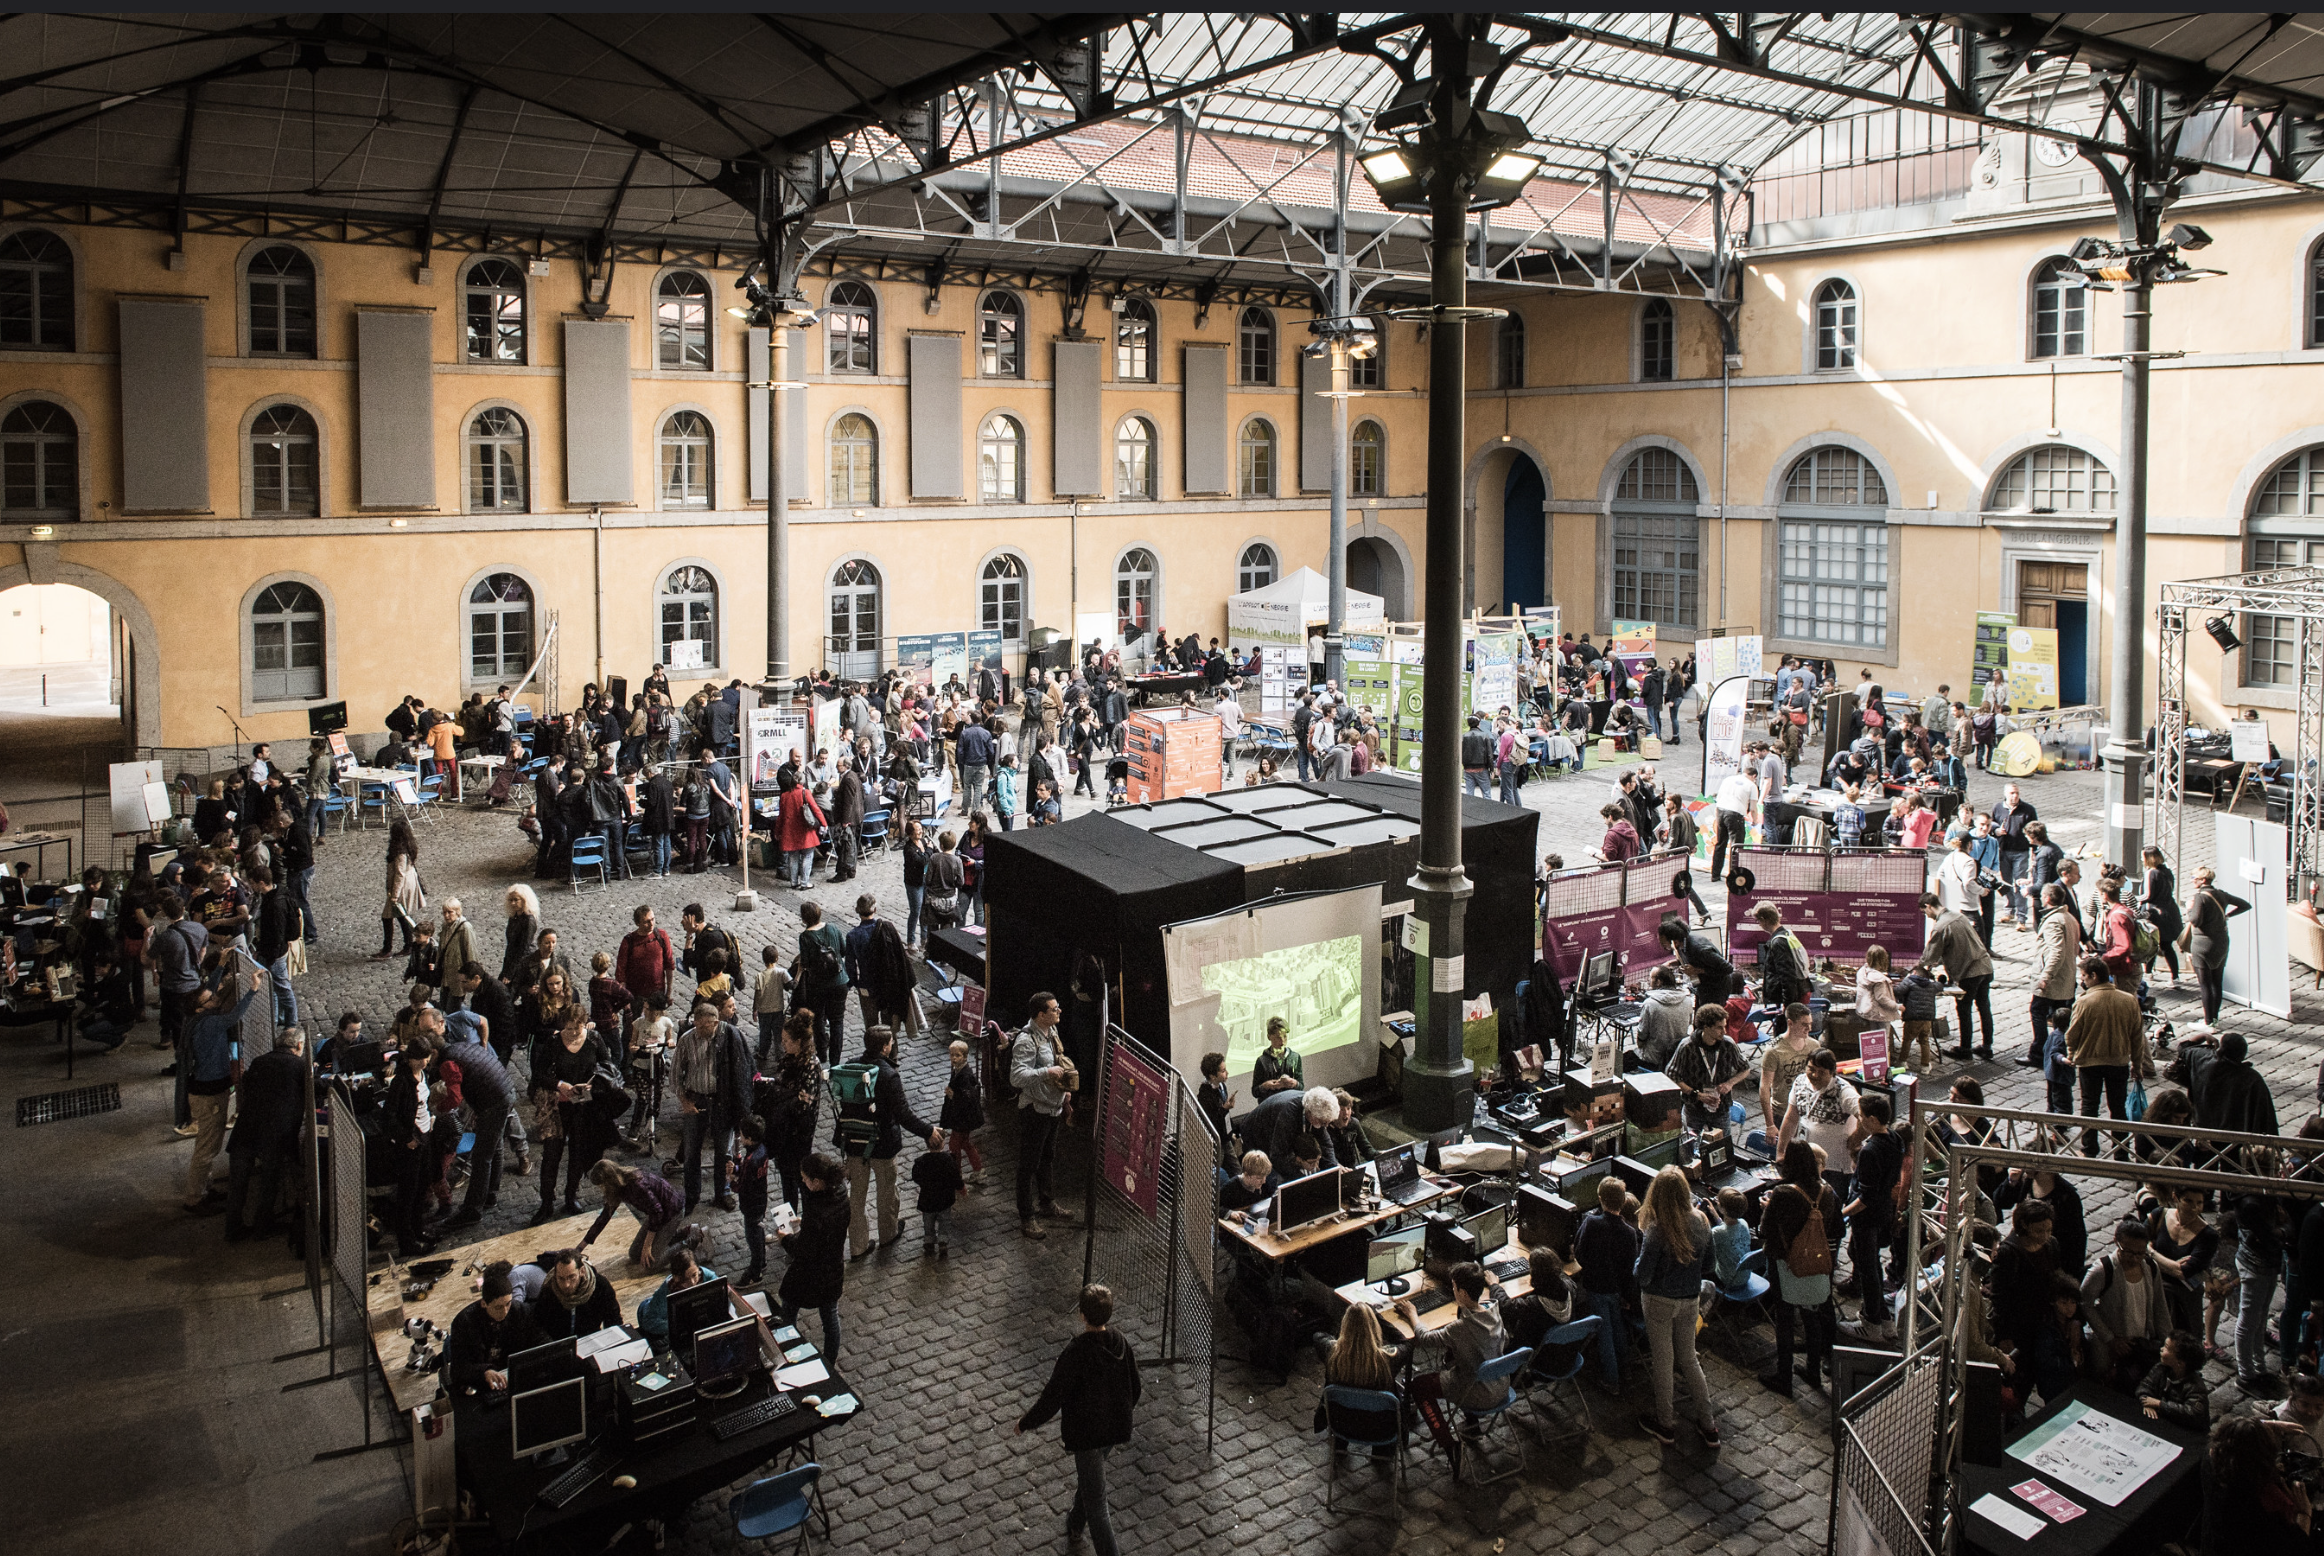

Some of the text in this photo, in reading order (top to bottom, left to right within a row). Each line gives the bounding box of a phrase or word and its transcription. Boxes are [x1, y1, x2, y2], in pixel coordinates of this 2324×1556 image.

[1714, 710, 1735, 725] Free
[764, 729, 787, 737] RMLL
[1713, 725, 1734, 738] LUG
